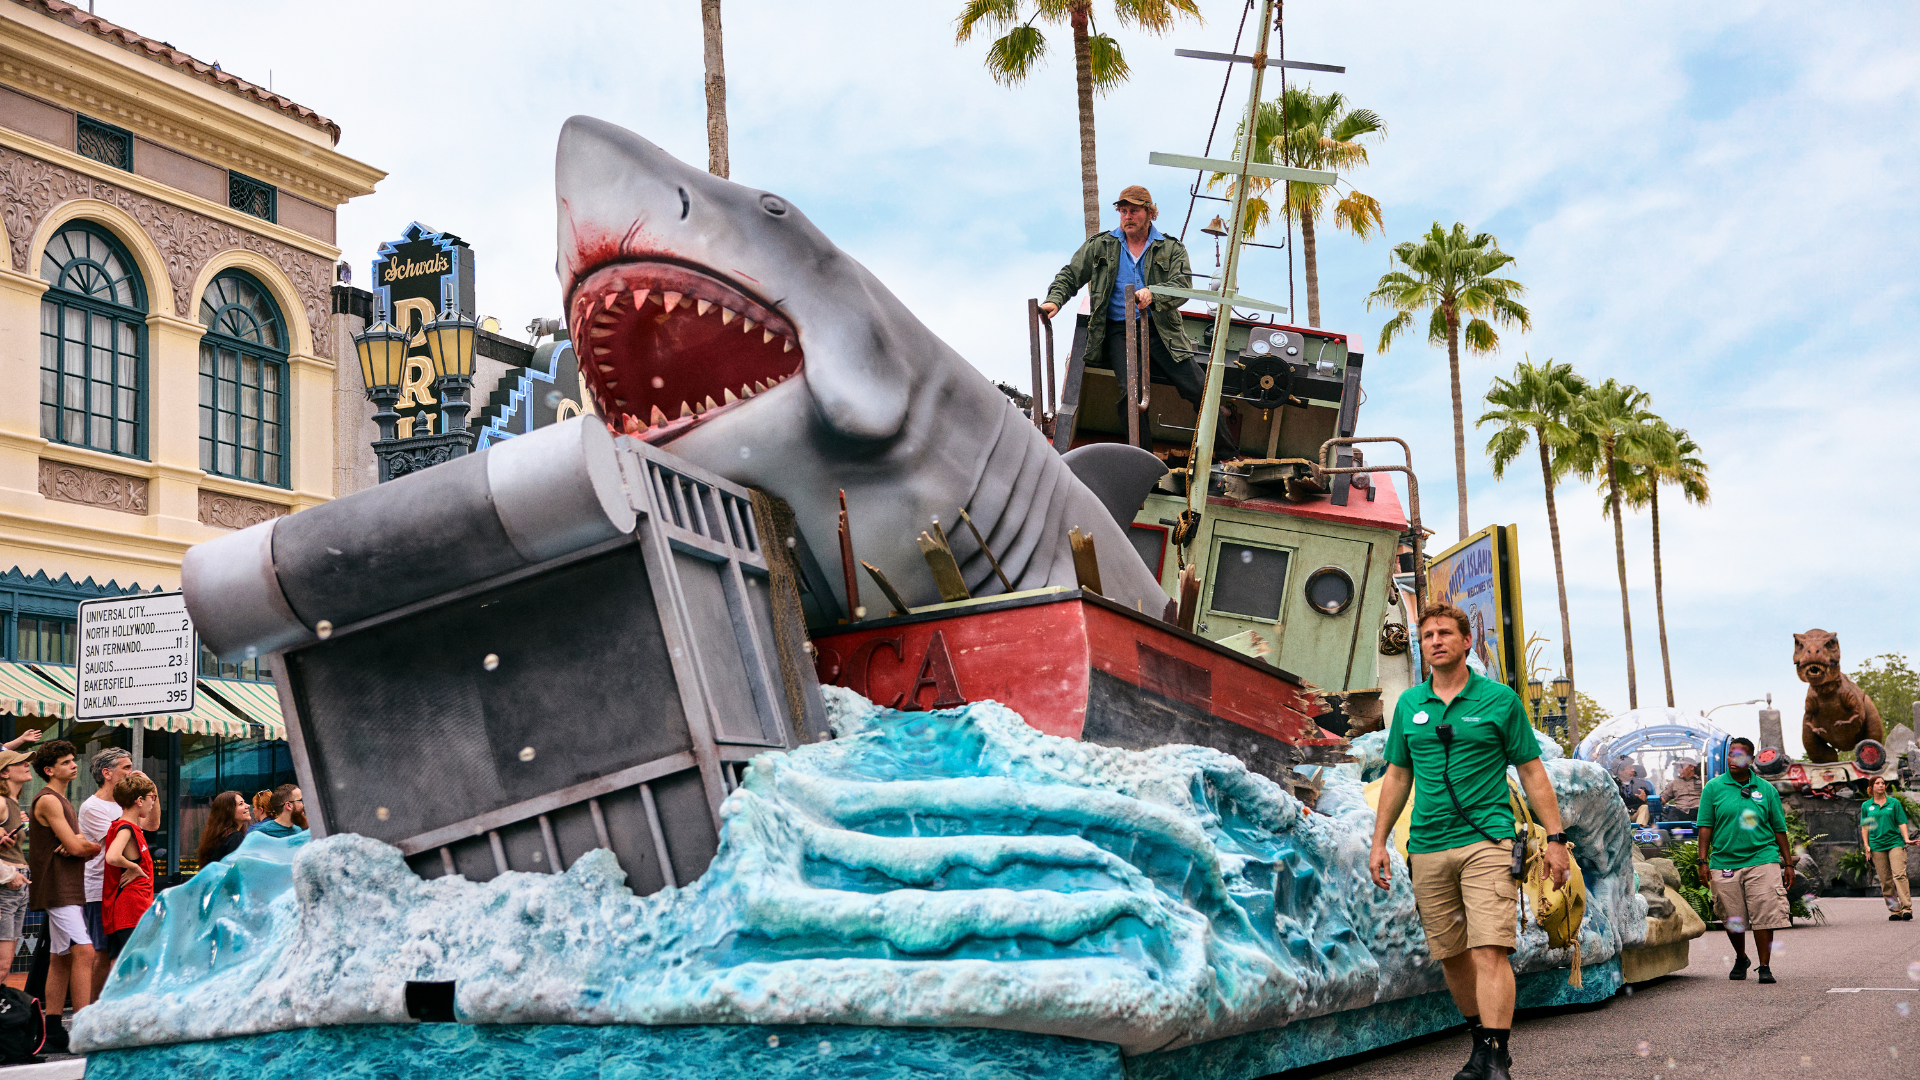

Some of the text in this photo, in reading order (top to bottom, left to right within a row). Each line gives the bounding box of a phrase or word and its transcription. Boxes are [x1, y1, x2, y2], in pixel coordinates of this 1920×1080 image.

[384, 253, 449, 281] Schwab's
[1467, 549, 1492, 578] ISLAND
[86, 606, 145, 623] UNIVERSAL CITY
[86, 619, 189, 640] NORTH HOLLYWOOD 2
[85, 644, 100, 657] SAN
[102, 641, 141, 656] FERNANDO
[85, 661, 114, 675] SAUGUS
[168, 655, 183, 667] 23
[84, 671, 188, 692] BAKERSFIELD 113
[83, 690, 188, 710] OAKLAND 395
